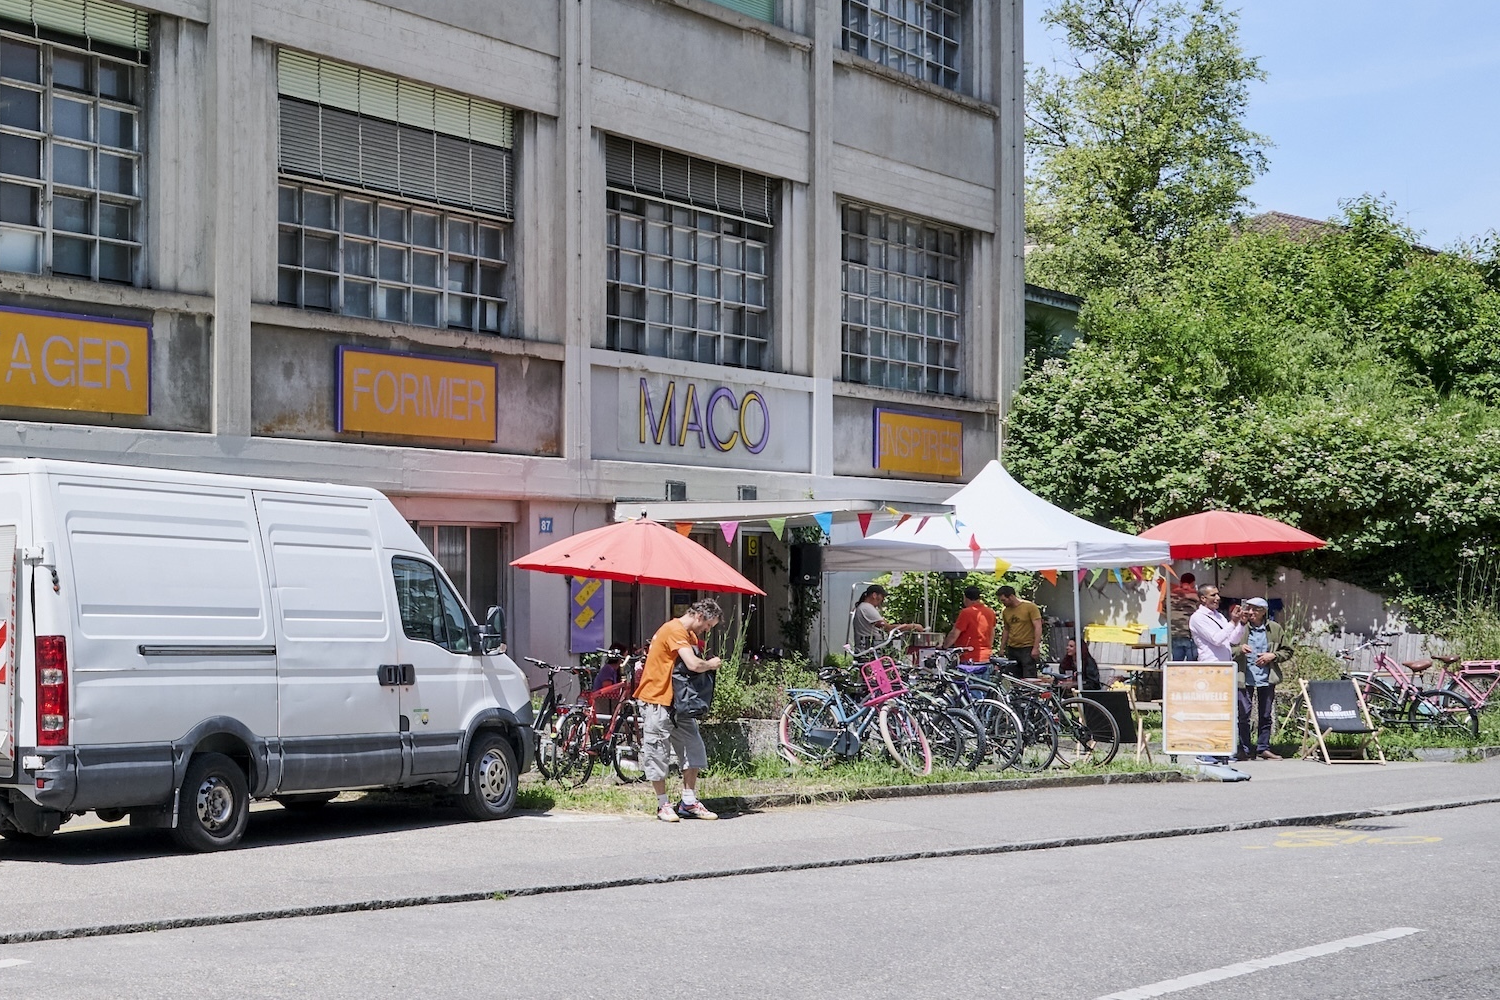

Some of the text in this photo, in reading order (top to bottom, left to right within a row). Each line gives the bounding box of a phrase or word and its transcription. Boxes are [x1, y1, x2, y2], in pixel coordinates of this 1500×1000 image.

[352, 367, 487, 422] FORMER
[638, 377, 771, 455] MACO
[880, 422, 962, 464] INSPIRER
[541, 520, 551, 531] 87
